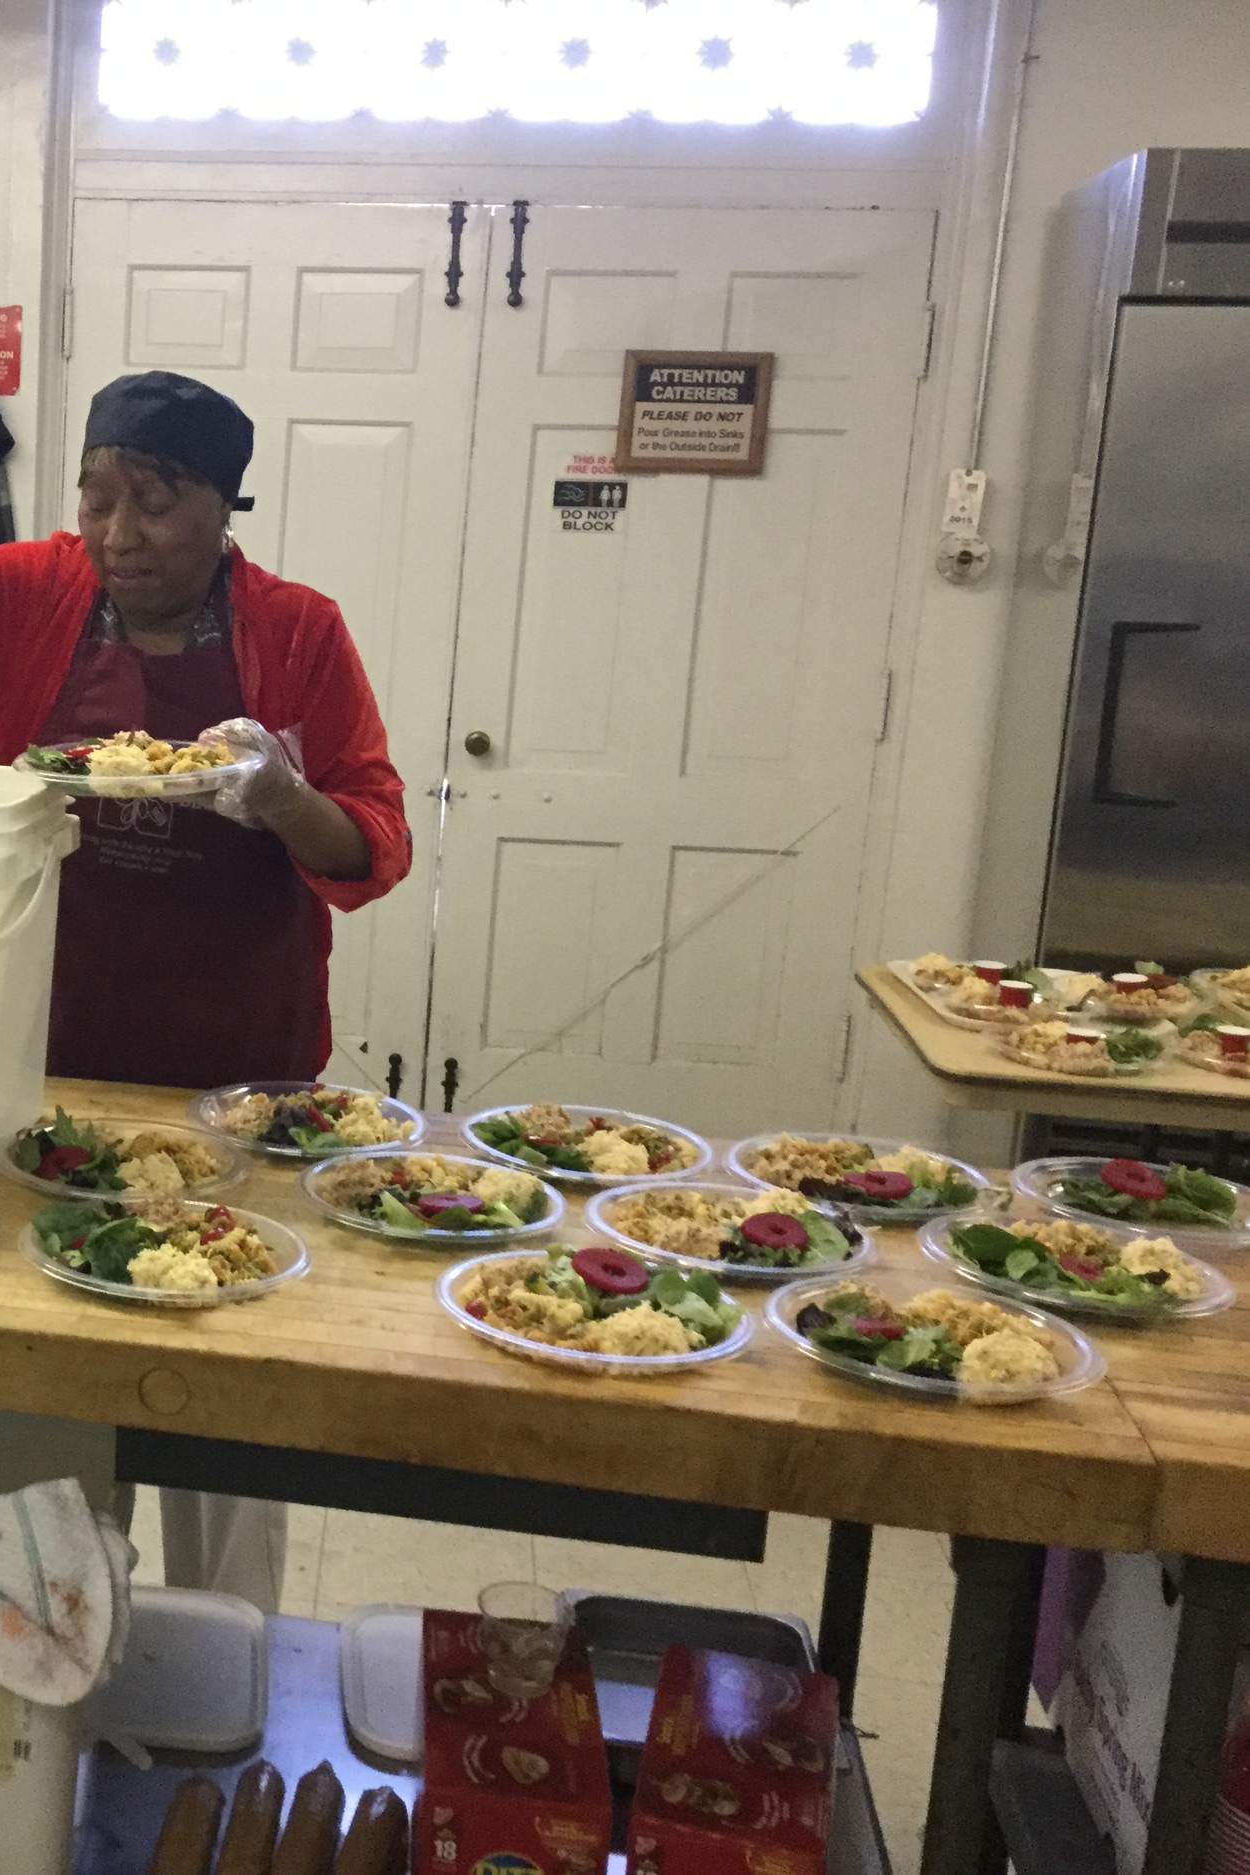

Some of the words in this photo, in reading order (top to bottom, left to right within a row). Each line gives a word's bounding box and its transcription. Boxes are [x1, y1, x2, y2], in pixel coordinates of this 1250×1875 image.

[649, 368, 745, 384] ATTENTION
[651, 385, 739, 401] CATERERS
[641, 410, 690, 421] PLEASE
[694, 411, 714, 421] DO
[716, 411, 744, 422] NOT
[637, 427, 660, 438] Pour
[662, 427, 697, 438] Grease
[698, 429, 717, 439] into
[719, 429, 745, 440] Sinks
[639, 442, 649, 450] or
[651, 441, 667, 451] the
[669, 441, 707, 452] Outside
[573, 455, 595, 464] THIS
[597, 456, 607, 465] IS
[567, 465, 588, 474] FIRE
[561, 509, 583, 519] DO
[587, 510, 618, 520] NOT
[562, 521, 615, 531] BLOCK
[434, 1839, 457, 1860] 18
